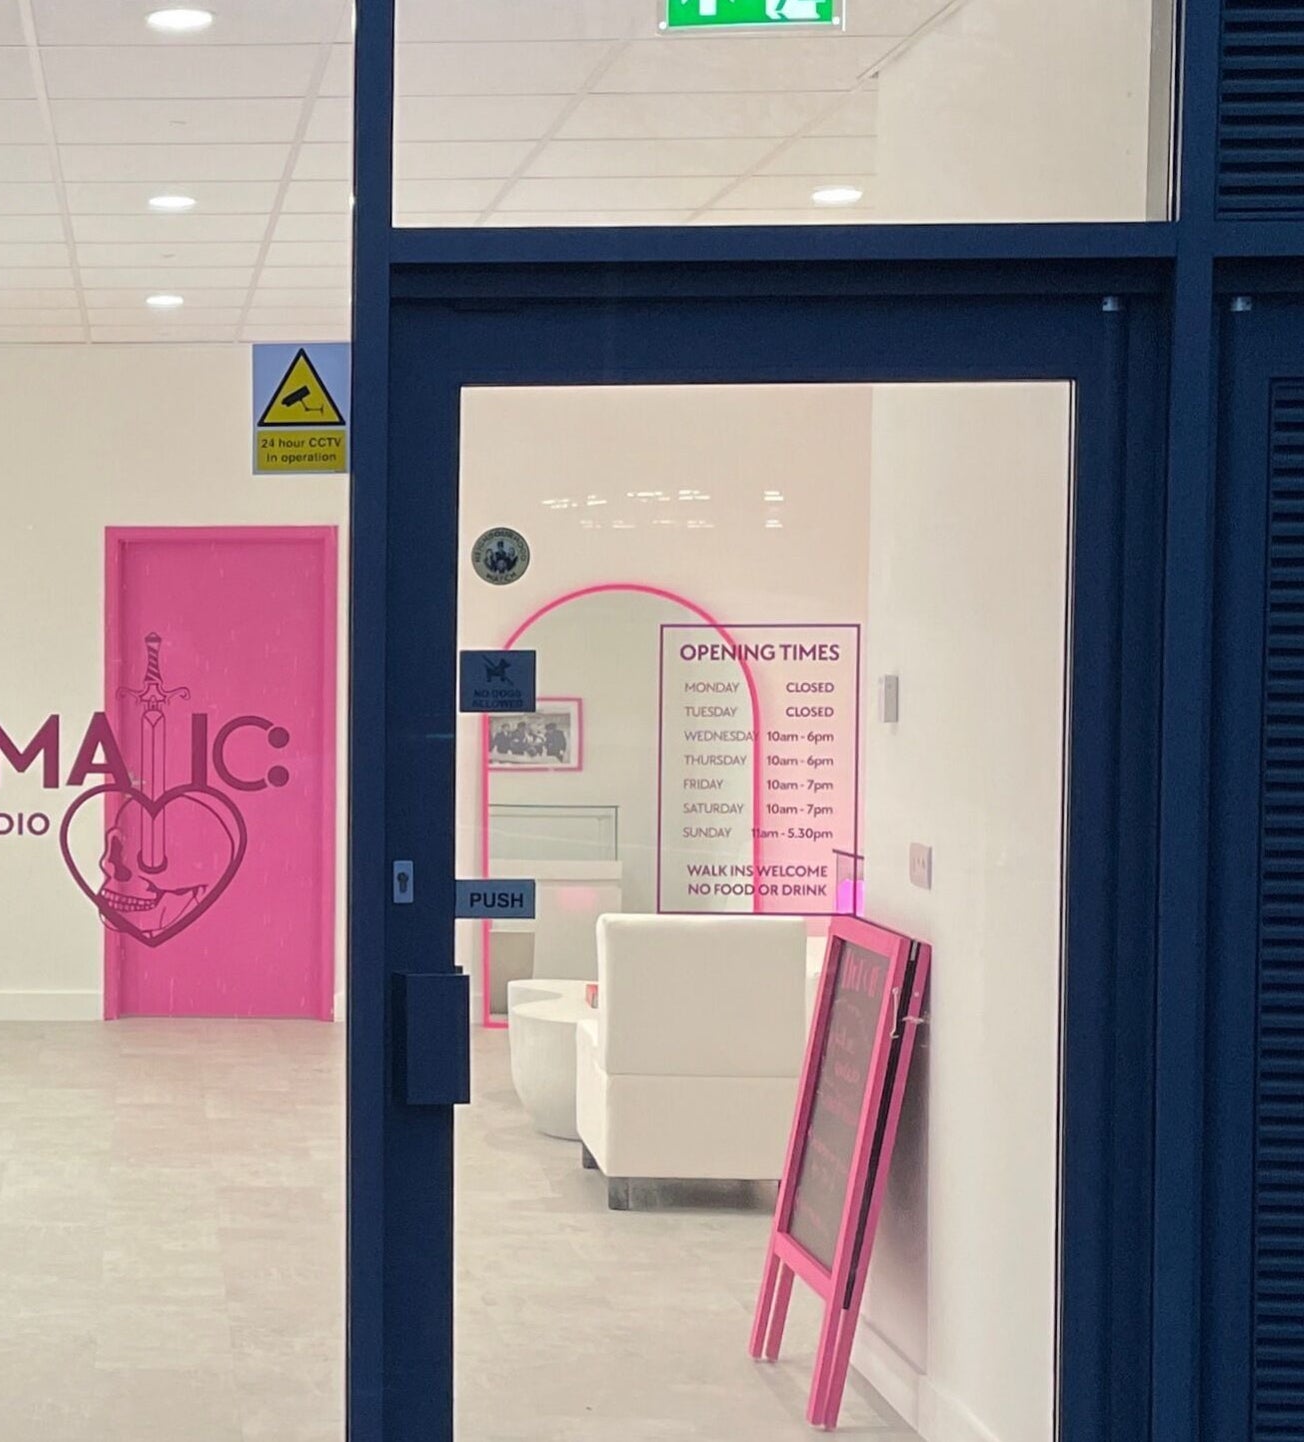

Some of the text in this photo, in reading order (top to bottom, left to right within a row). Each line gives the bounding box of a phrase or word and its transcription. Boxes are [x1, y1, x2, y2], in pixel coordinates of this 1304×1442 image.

[261, 437, 341, 448] 24 hour CCTV
[281, 453, 336, 464] operation
[679, 644, 840, 661] OPENING TIMES
[474, 688, 522, 698] NO DOGS
[684, 682, 835, 694] MONDAY CLOSED
[684, 706, 834, 718] TUESDAY CLOSED
[684, 730, 760, 742] WEDNESDAY
[767, 731, 798, 742] 10am
[807, 731, 834, 745] 6pm
[684, 755, 747, 766] THURSDAY
[767, 755, 798, 766] 10am
[807, 755, 834, 769] 6pm
[683, 779, 724, 790] FRIDAY
[766, 780, 798, 790] 10am
[807, 780, 833, 794] 7pm
[683, 803, 744, 814] SATURDAY
[766, 804, 798, 814] 10am
[807, 804, 833, 818] 7pm
[682, 827, 732, 838] SUNDAY
[751, 828, 779, 838] 11am
[787, 828, 833, 842] 5.30pm
[687, 865, 828, 877] WALK INS WELCOME
[688, 884, 827, 896] NO FOOD OR DRINK
[469, 892, 524, 908] PUSH
